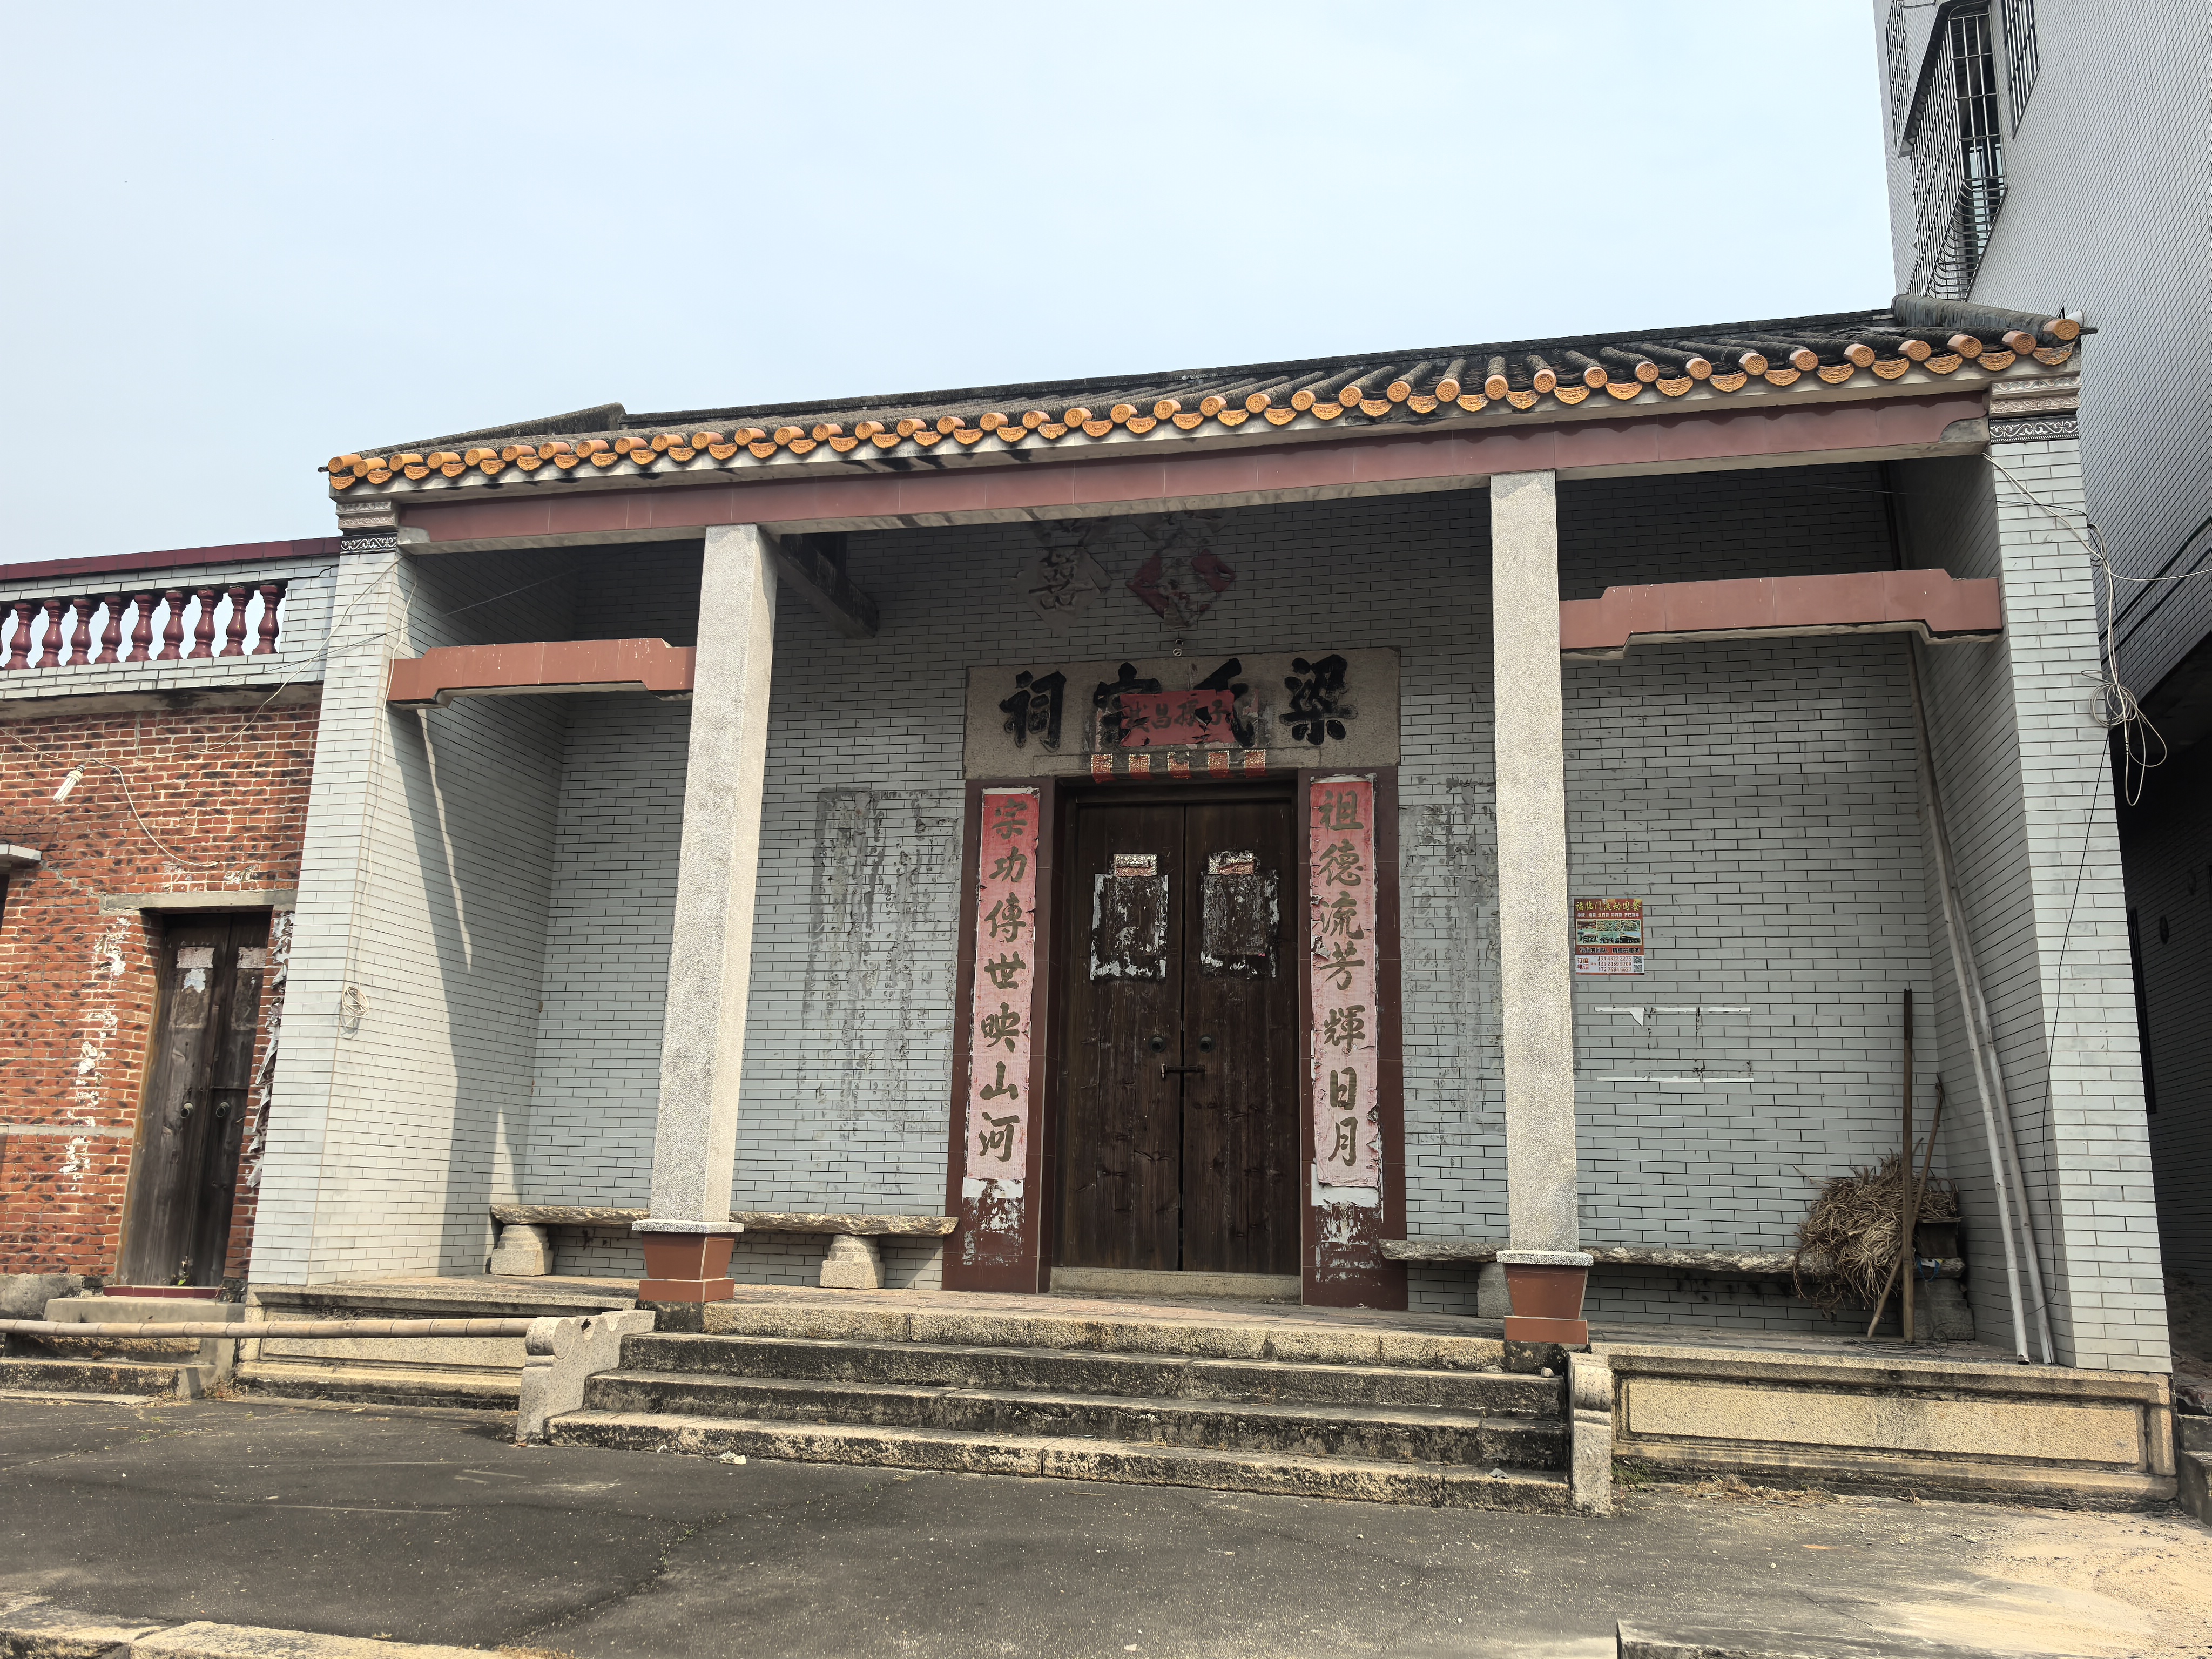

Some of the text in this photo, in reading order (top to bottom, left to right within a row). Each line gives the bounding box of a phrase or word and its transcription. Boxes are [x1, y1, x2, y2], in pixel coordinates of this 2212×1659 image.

[979, 798, 1029, 1163] 宗功傳世映山河
[1318, 790, 1366, 1167] 祖德流芳輝日月
